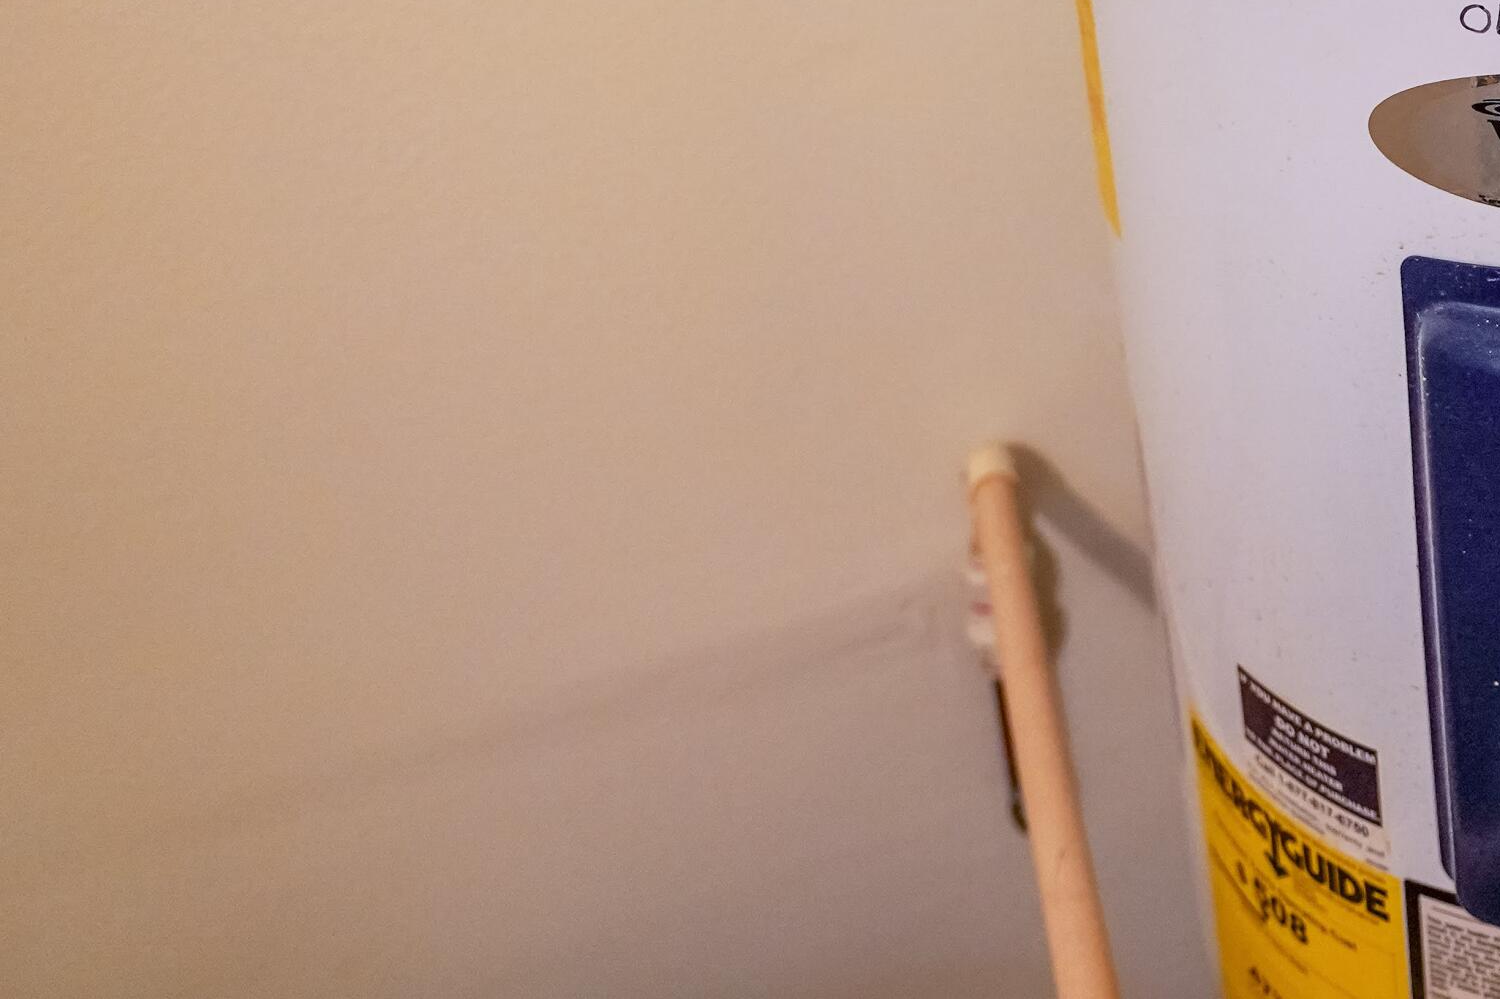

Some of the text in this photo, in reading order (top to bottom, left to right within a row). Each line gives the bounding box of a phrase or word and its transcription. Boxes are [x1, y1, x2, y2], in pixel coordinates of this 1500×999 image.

[1274, 714, 1295, 737] DO
[1296, 731, 1330, 758] NOT
[1314, 726, 1376, 765] PROBLEM
